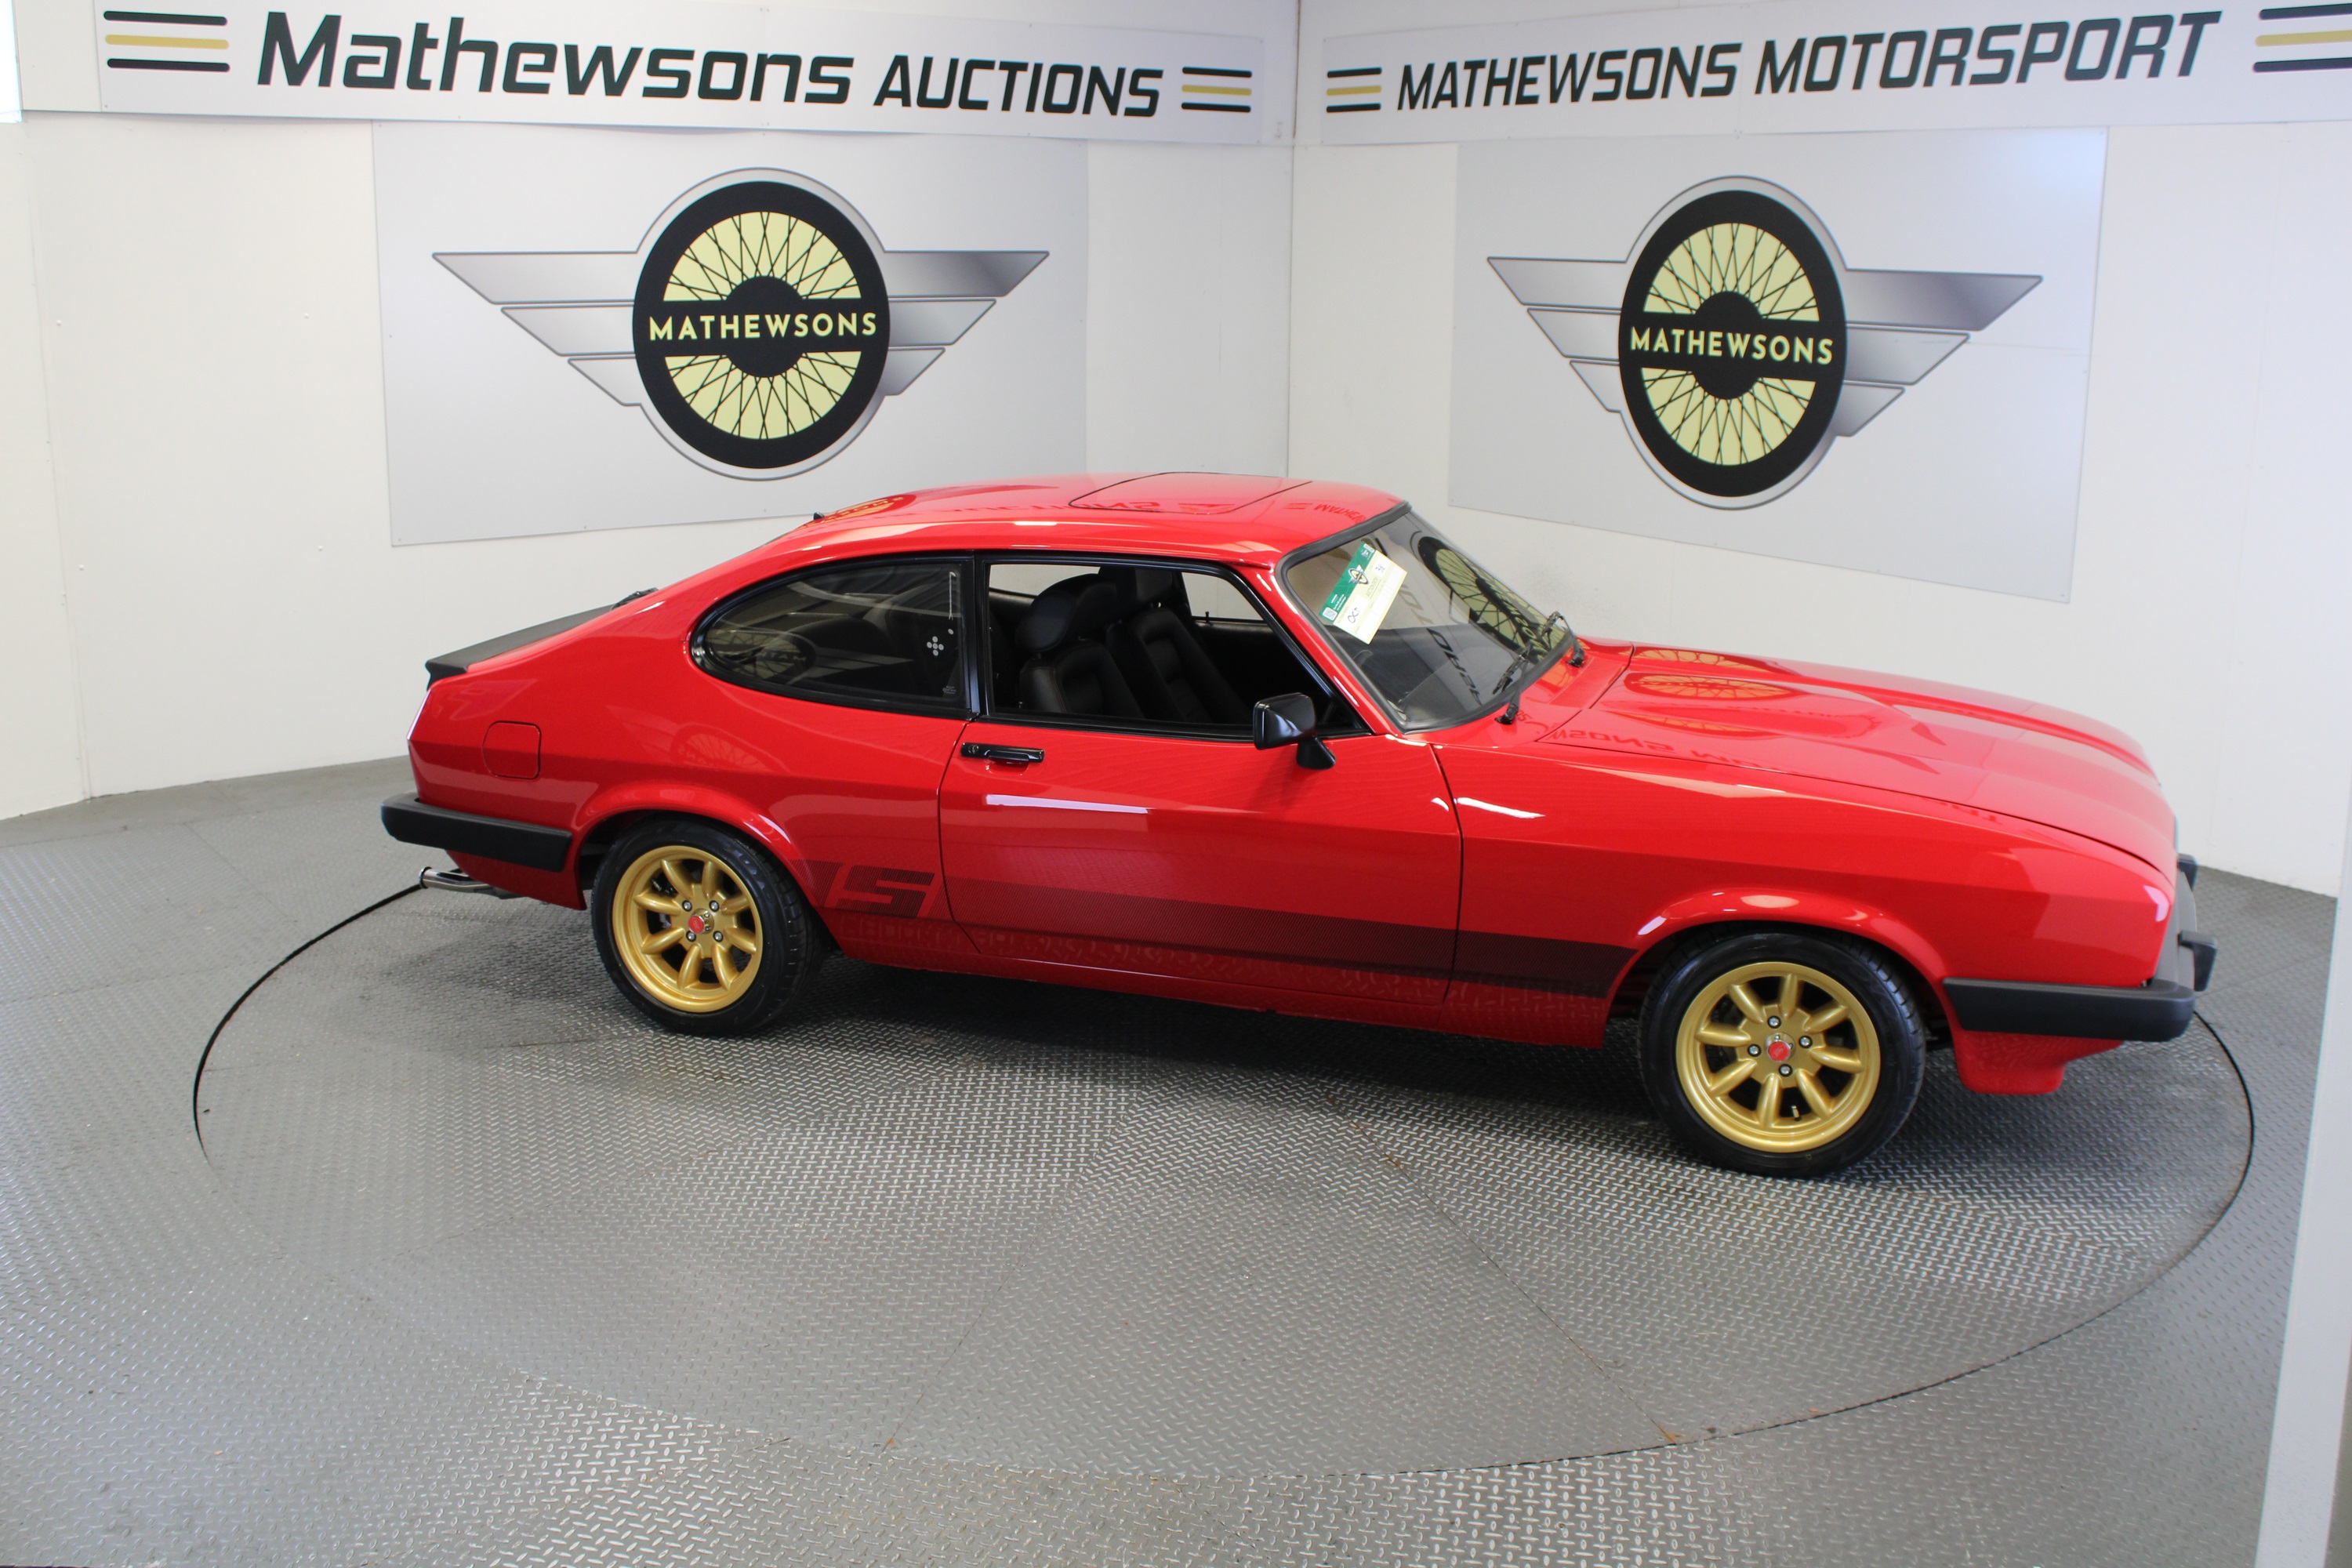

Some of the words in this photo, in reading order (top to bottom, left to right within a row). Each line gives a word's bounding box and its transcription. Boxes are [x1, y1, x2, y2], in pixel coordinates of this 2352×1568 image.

[258, 12, 854, 104] Mathewsons
[873, 56, 1163, 118] AUCTIONS
[1398, 50, 1742, 110] MATHEWSONS
[1755, 11, 2222, 95] MOTORSPORT
[649, 312, 877, 340] MATHEWSONS
[1631, 326, 1833, 365] MATHEWSONS
